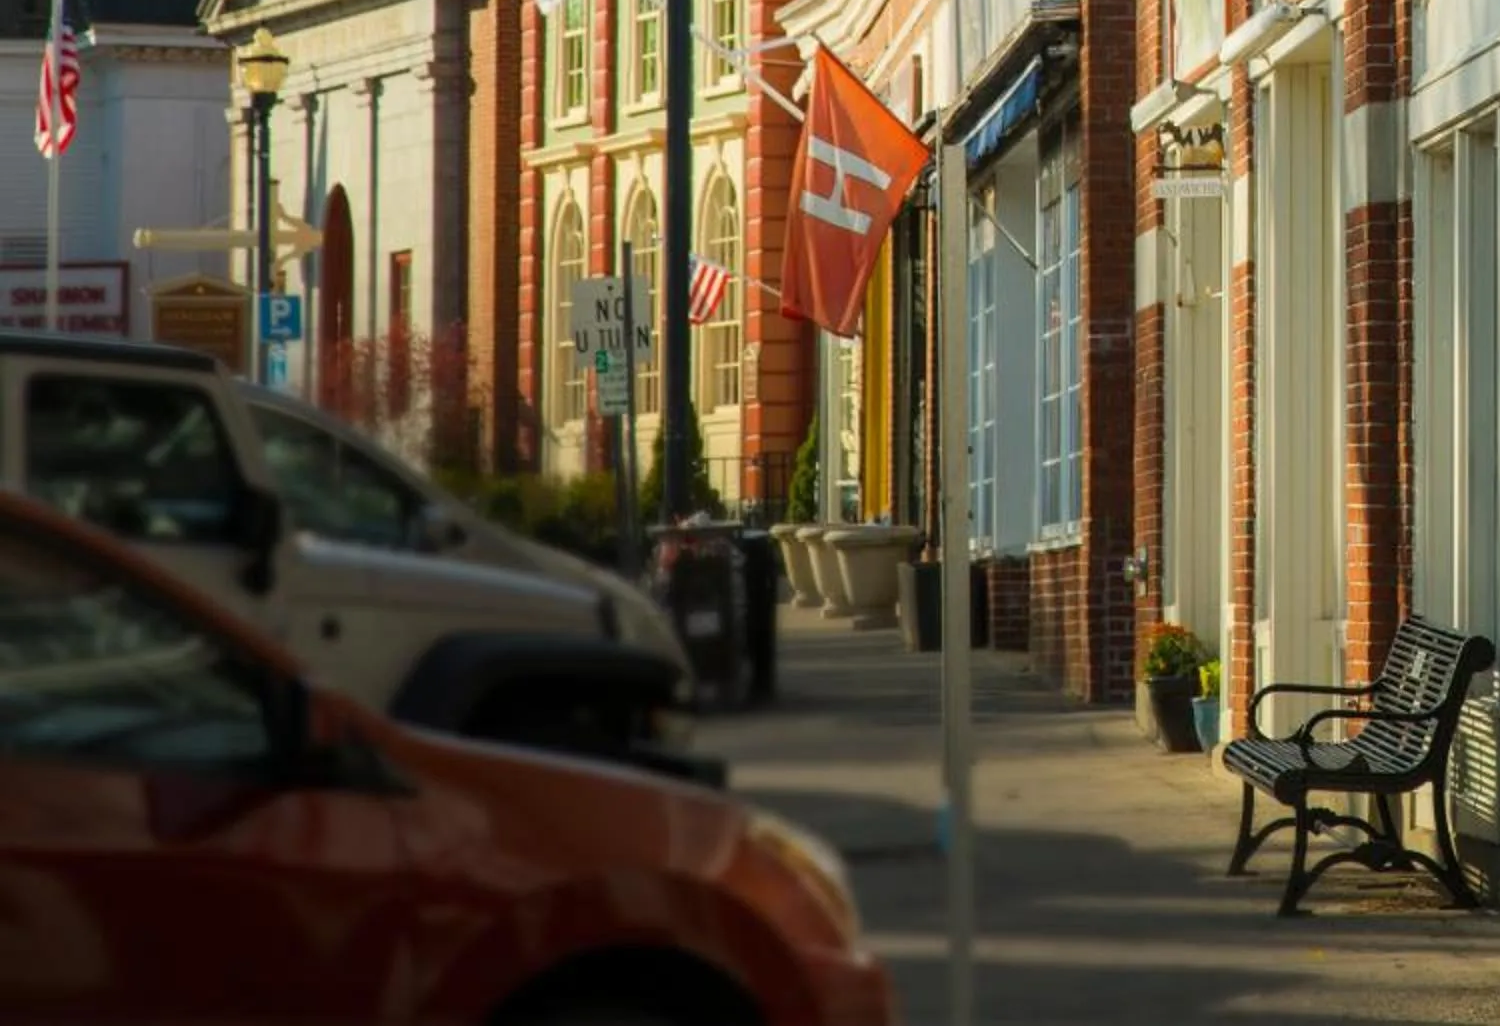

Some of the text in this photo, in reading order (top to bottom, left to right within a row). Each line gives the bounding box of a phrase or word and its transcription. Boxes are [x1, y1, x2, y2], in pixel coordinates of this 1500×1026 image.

[271, 299, 291, 327] P
[576, 326, 649, 353] U TUN
